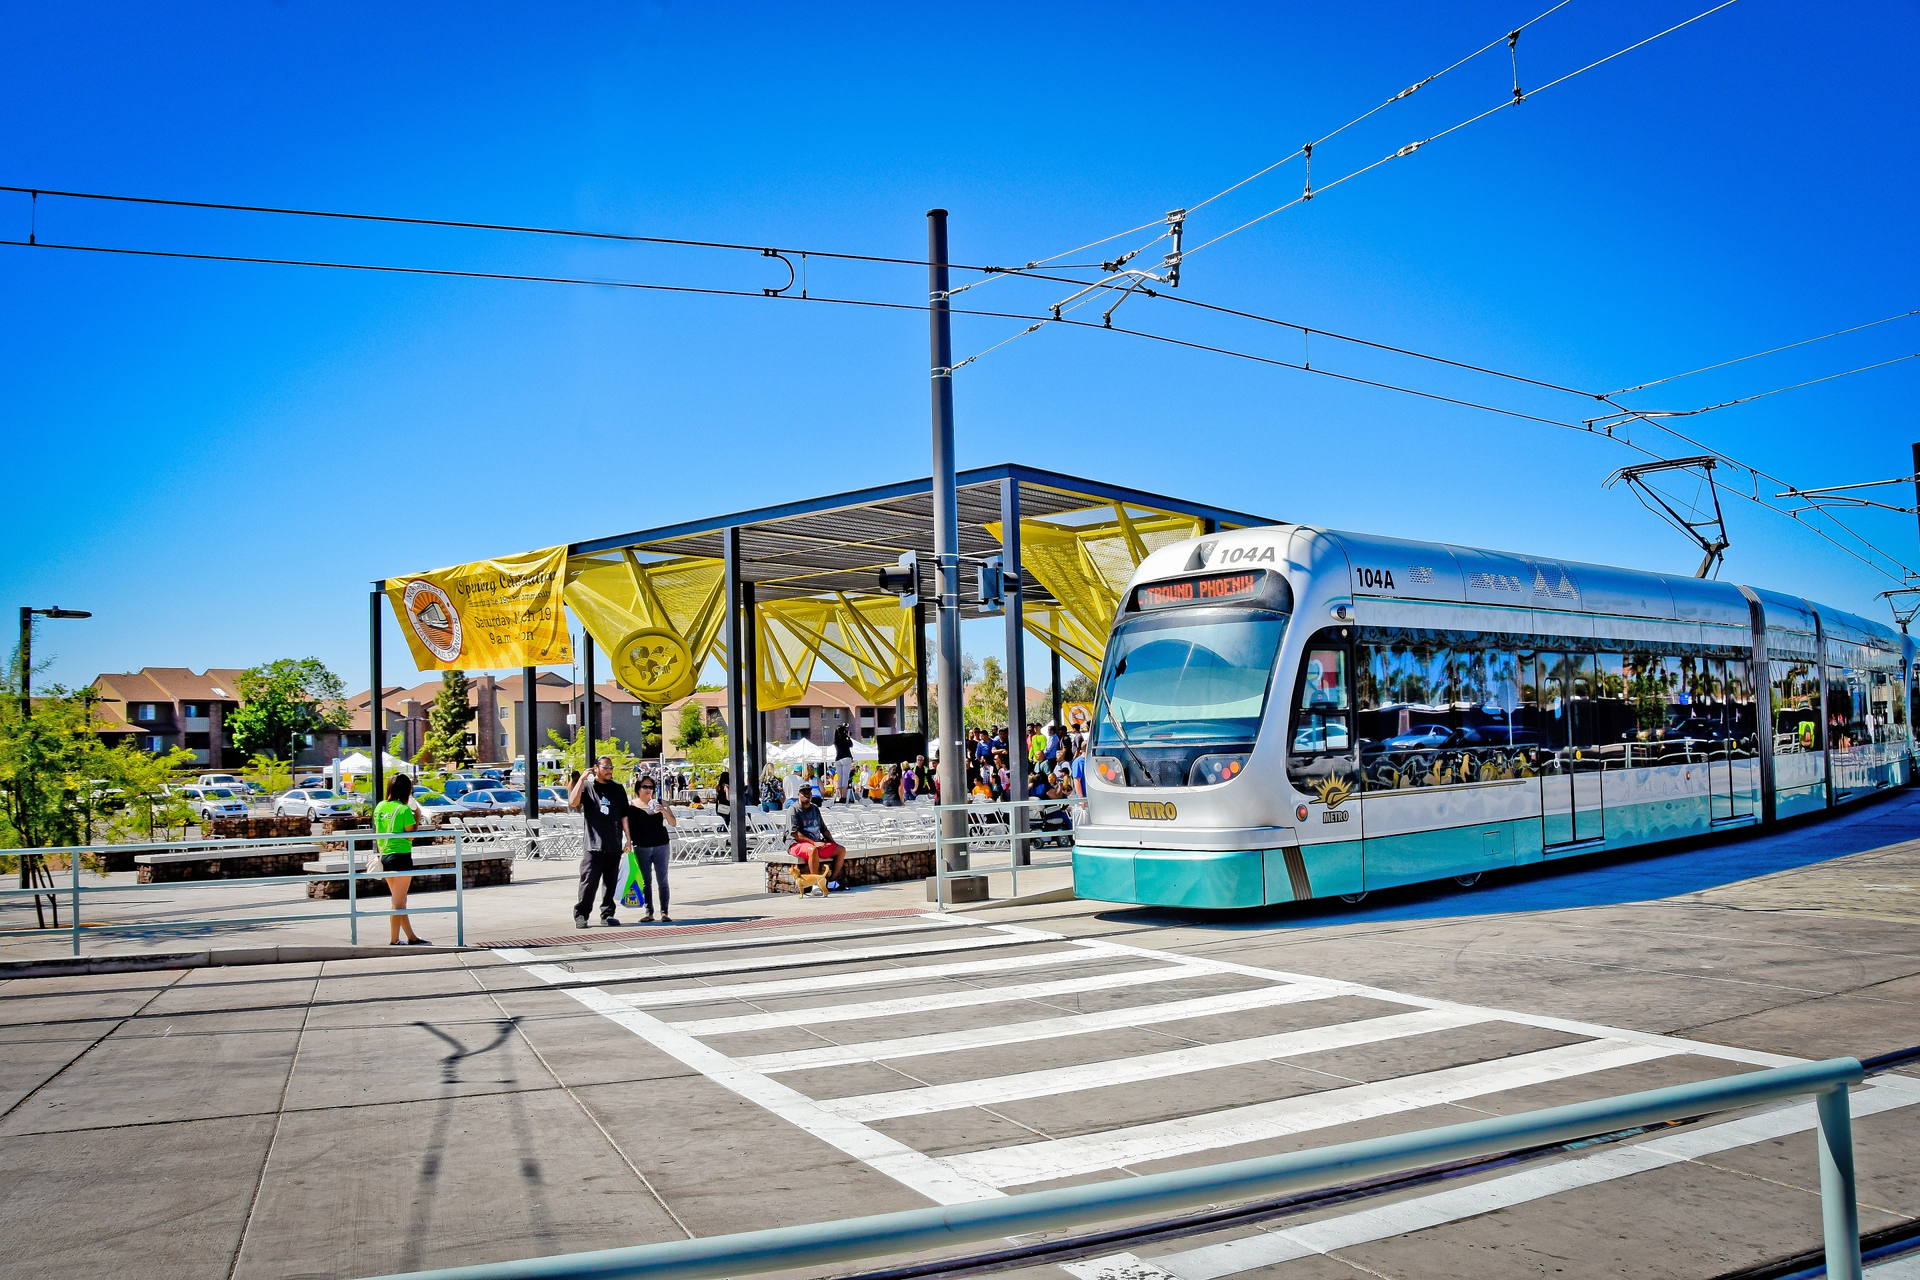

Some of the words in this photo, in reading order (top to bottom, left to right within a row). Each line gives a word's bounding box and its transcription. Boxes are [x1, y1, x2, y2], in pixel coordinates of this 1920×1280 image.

[1220, 547, 1275, 564] 104A
[1199, 575, 1255, 599] PHOENIX
[1356, 567, 1395, 589] 104A
[514, 609, 535, 624] Mch
[539, 607, 552, 621] 19
[1129, 801, 1177, 820] METRO
[1323, 810, 1349, 824] METRO
